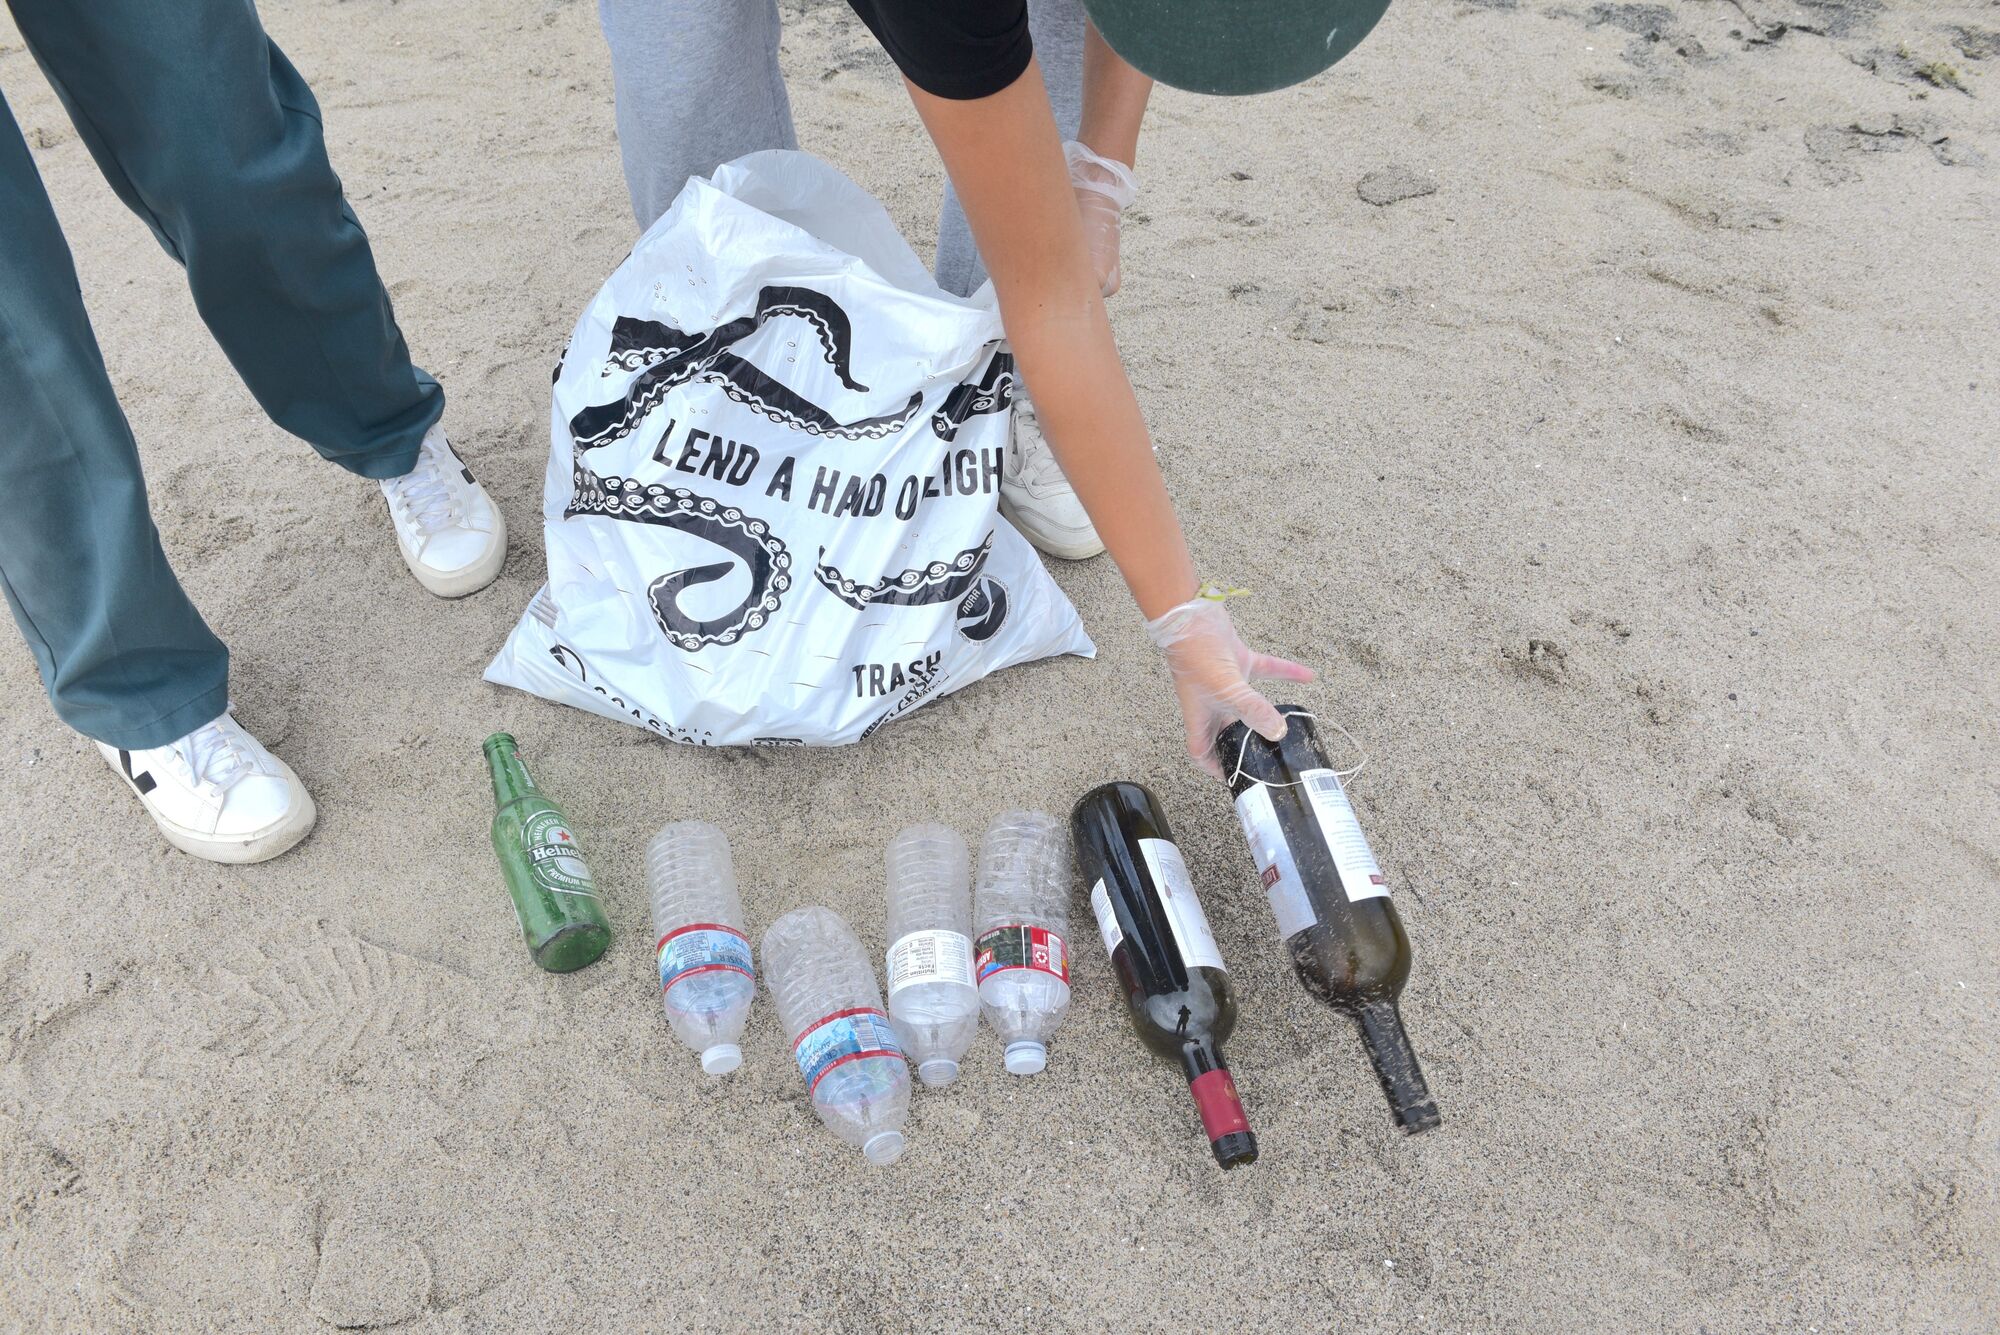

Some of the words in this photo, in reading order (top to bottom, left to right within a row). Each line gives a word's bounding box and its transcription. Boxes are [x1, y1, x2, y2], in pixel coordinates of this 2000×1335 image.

[652, 418, 760, 486] LEND
[765, 456, 796, 502] A
[807, 465, 888, 518] HAD
[547, 868, 580, 885] PREMIUM
